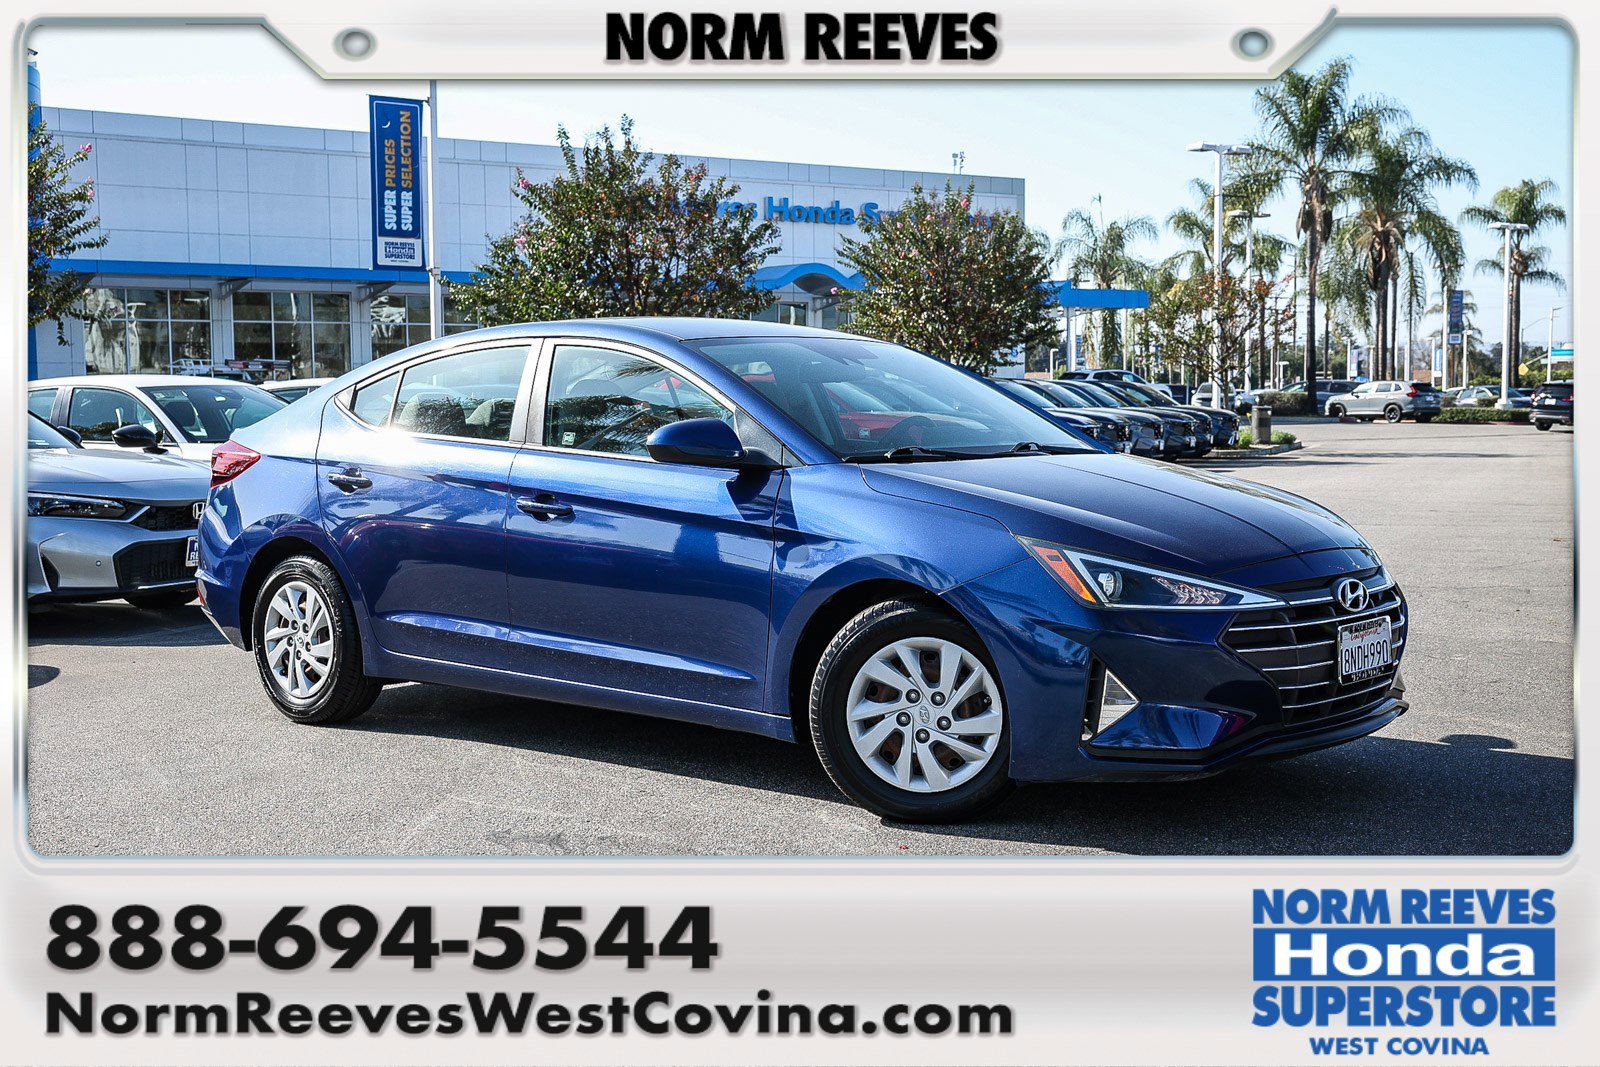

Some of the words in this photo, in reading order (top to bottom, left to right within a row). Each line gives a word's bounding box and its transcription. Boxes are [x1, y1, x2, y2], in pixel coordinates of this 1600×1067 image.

[384, 138, 396, 188] PRICES
[400, 110, 413, 189] SELECTION
[384, 189, 397, 231] SUPER
[400, 190, 413, 232] SUPER
[763, 196, 855, 225] Honda
[1344, 640, 1389, 673] 8NDH990
